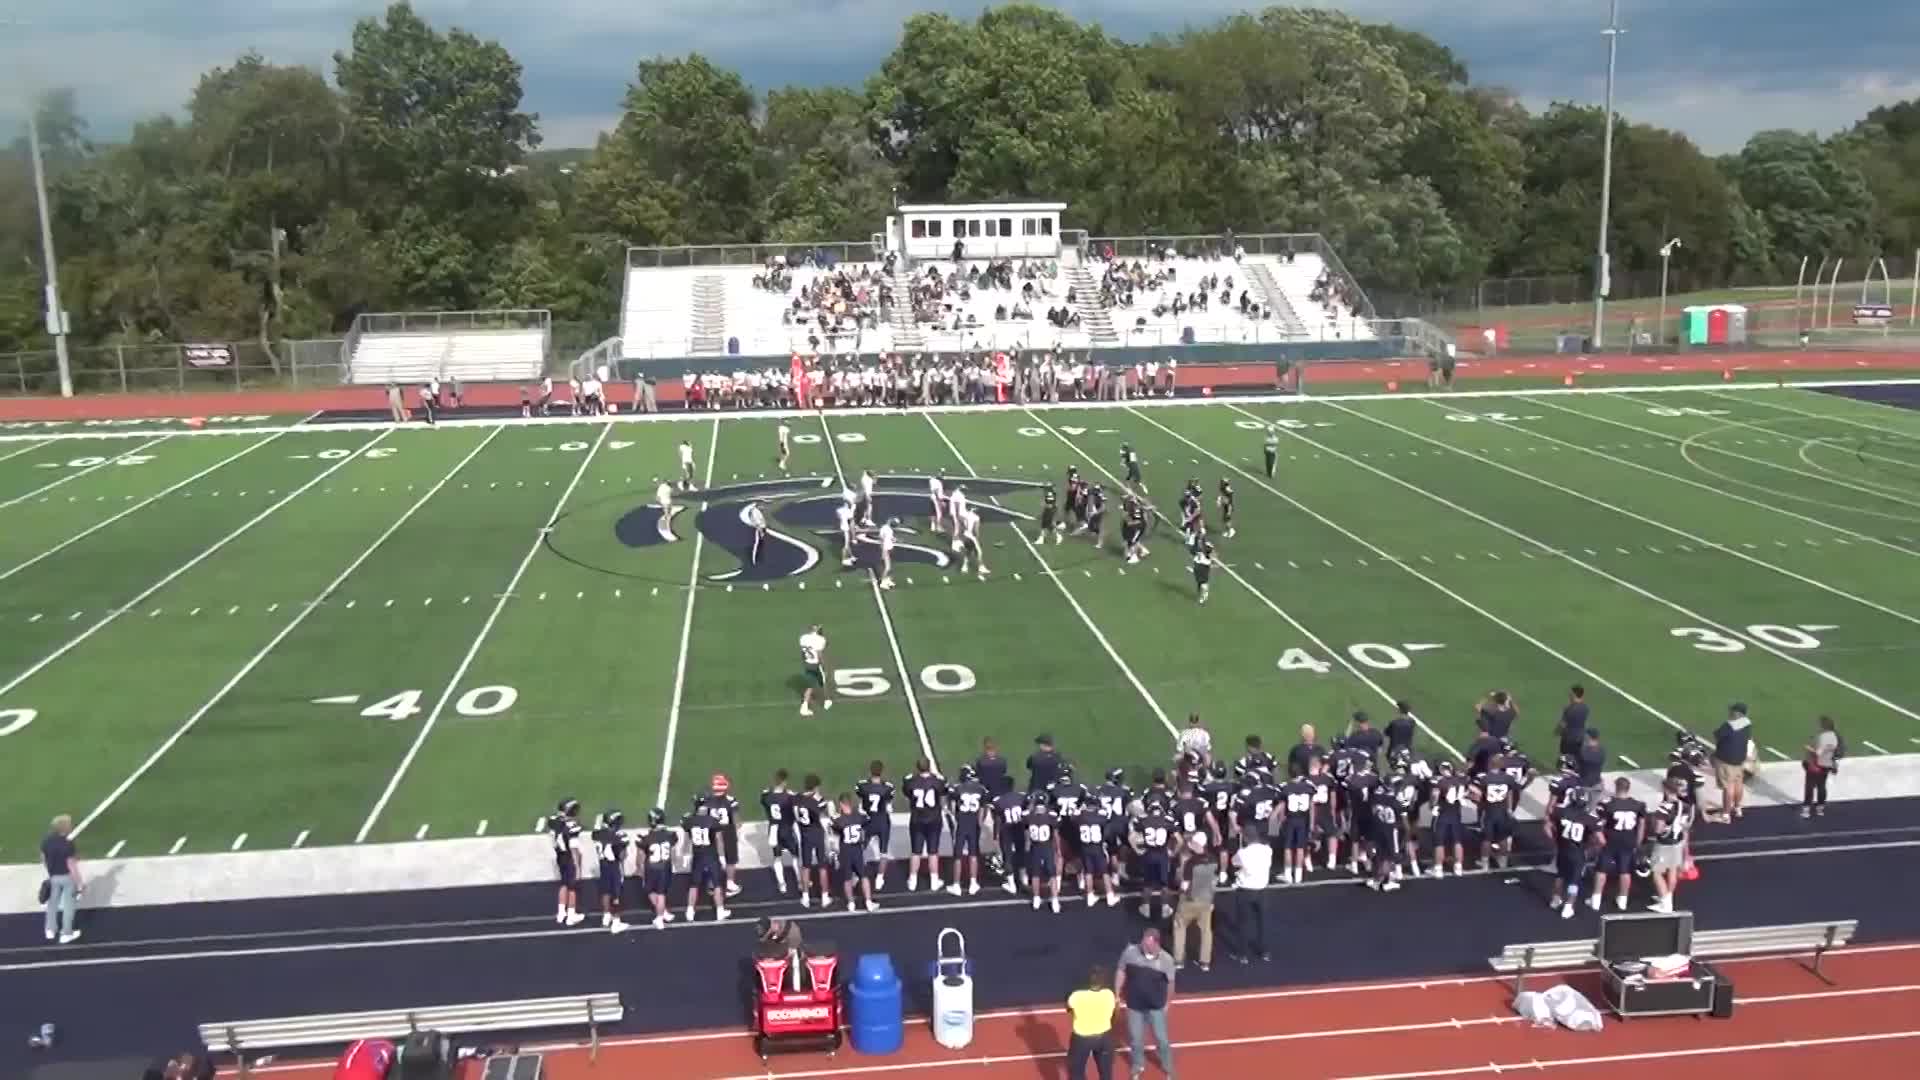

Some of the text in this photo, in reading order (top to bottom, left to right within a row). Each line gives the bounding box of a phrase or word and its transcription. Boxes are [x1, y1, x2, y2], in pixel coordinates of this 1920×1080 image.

[1669, 624, 1821, 653] 30
[1277, 642, 1412, 673] 40
[833, 663, 977, 697] 50
[359, 685, 519, 720] 40
[868, 793, 882, 812] 7
[912, 788, 937, 809] 74
[843, 824, 862, 845] 15
[1560, 818, 1585, 843] 70
